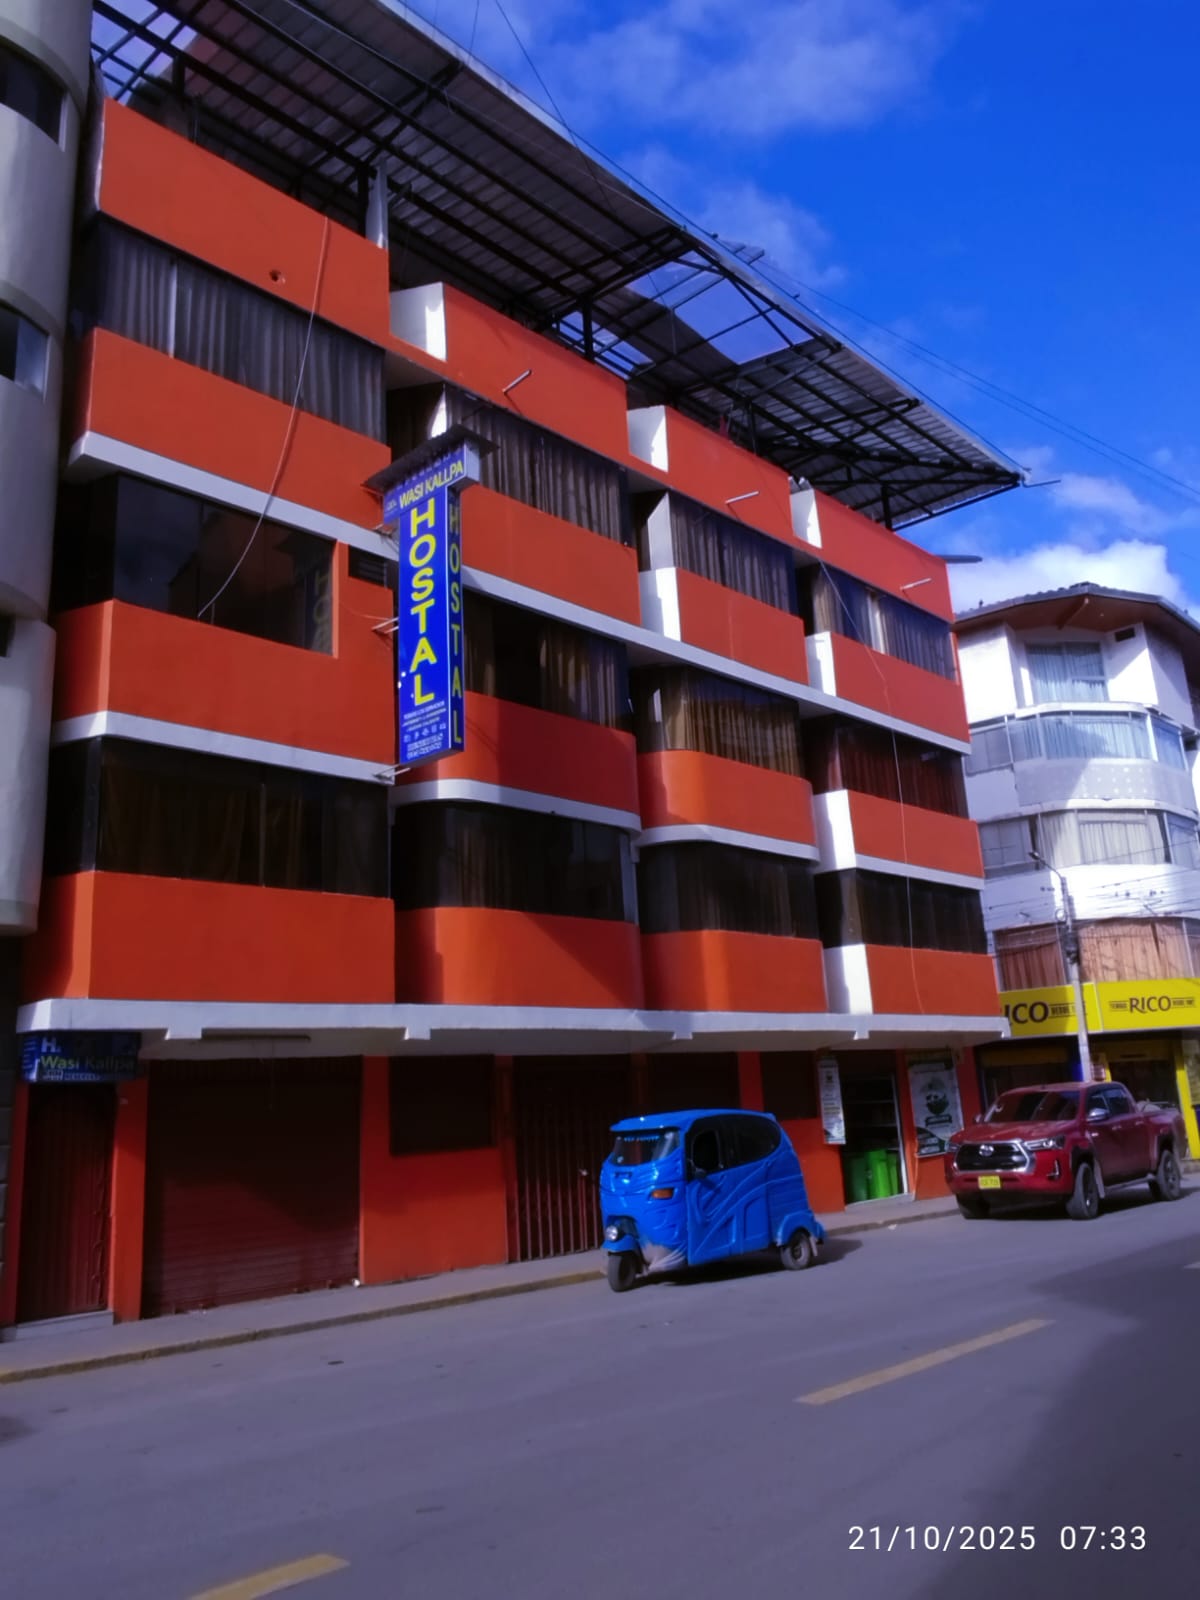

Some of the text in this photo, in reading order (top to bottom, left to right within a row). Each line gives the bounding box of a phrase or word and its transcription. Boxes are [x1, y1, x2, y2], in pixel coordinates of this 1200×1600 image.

[399, 481, 424, 509] WASI
[425, 460, 464, 495] KALLPA
[409, 497, 437, 706] HOSTAL
[449, 503, 462, 743] HOSTAL
[1003, 1001, 1050, 1025] ICO
[1129, 995, 1171, 1014] RICO
[40, 1055, 135, 1073] Wasi Kallpa
